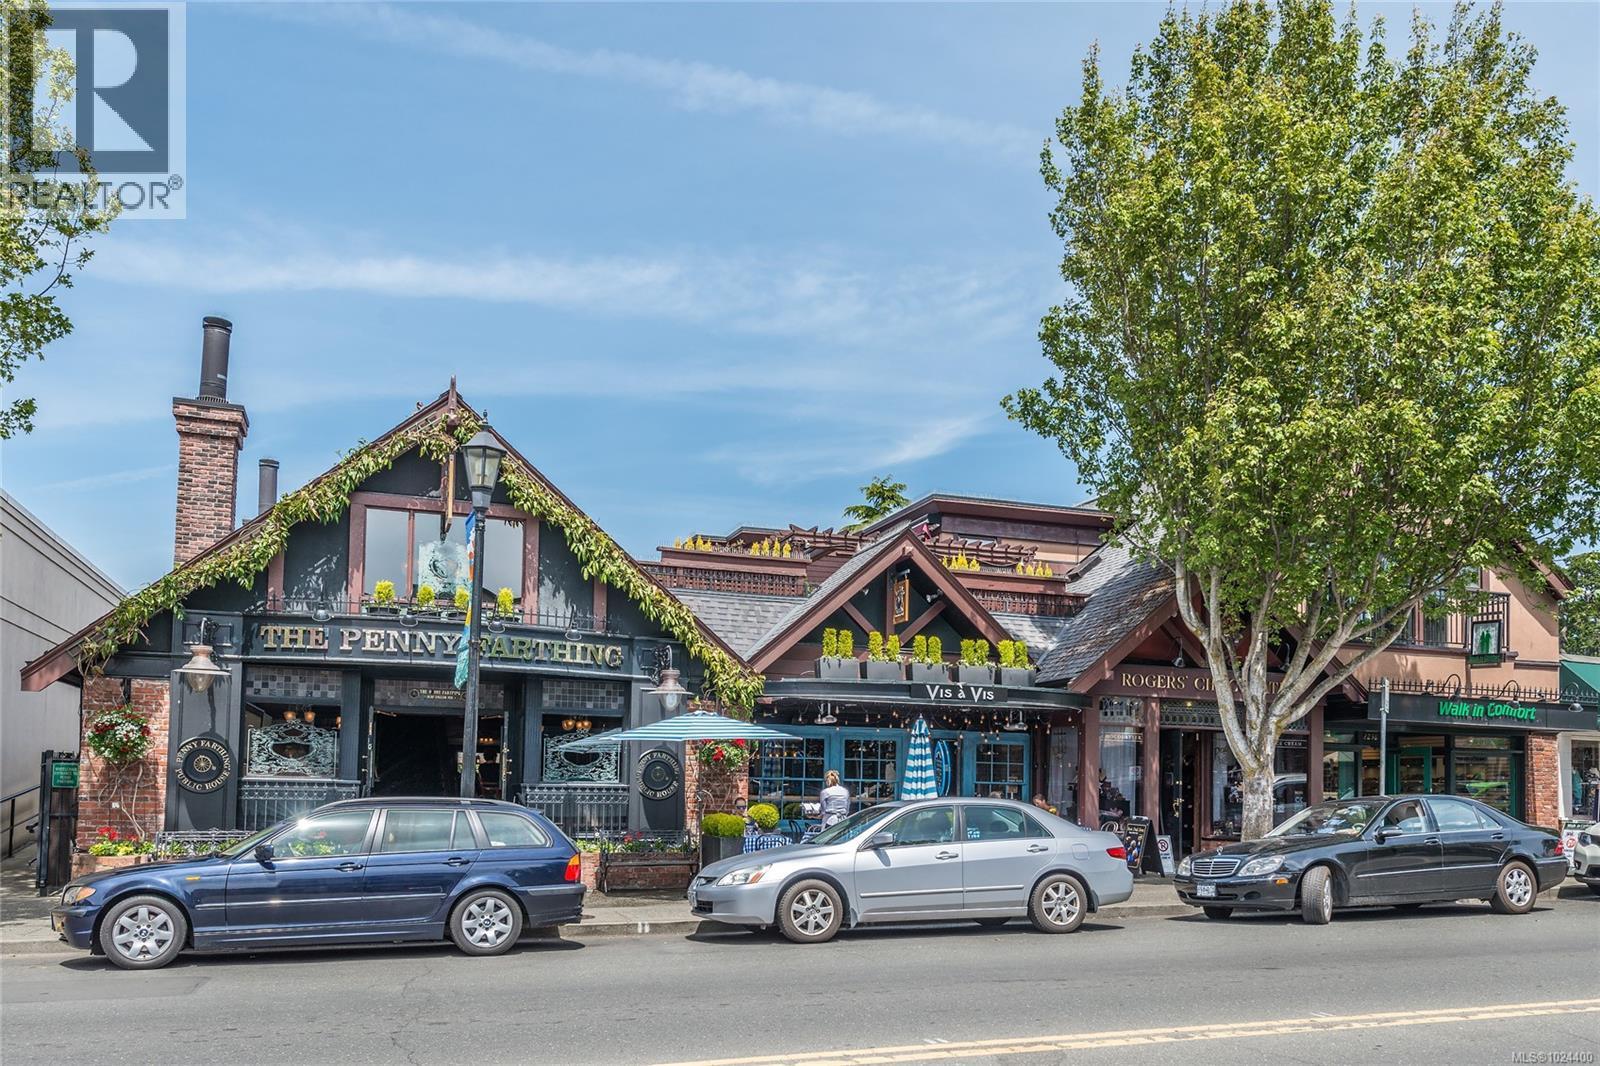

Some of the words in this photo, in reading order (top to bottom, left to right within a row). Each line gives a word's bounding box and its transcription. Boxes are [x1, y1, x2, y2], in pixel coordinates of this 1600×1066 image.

[260, 625, 328, 650] THE
[339, 628, 462, 655] PENNY
[1439, 701, 1470, 716] Walk
[1472, 703, 1485, 717] in
[176, 740, 199, 763] PENNY
[200, 740, 231, 769] FARTHING
[175, 768, 203, 790] PUBLIC
[205, 770, 230, 790] HOUSE
